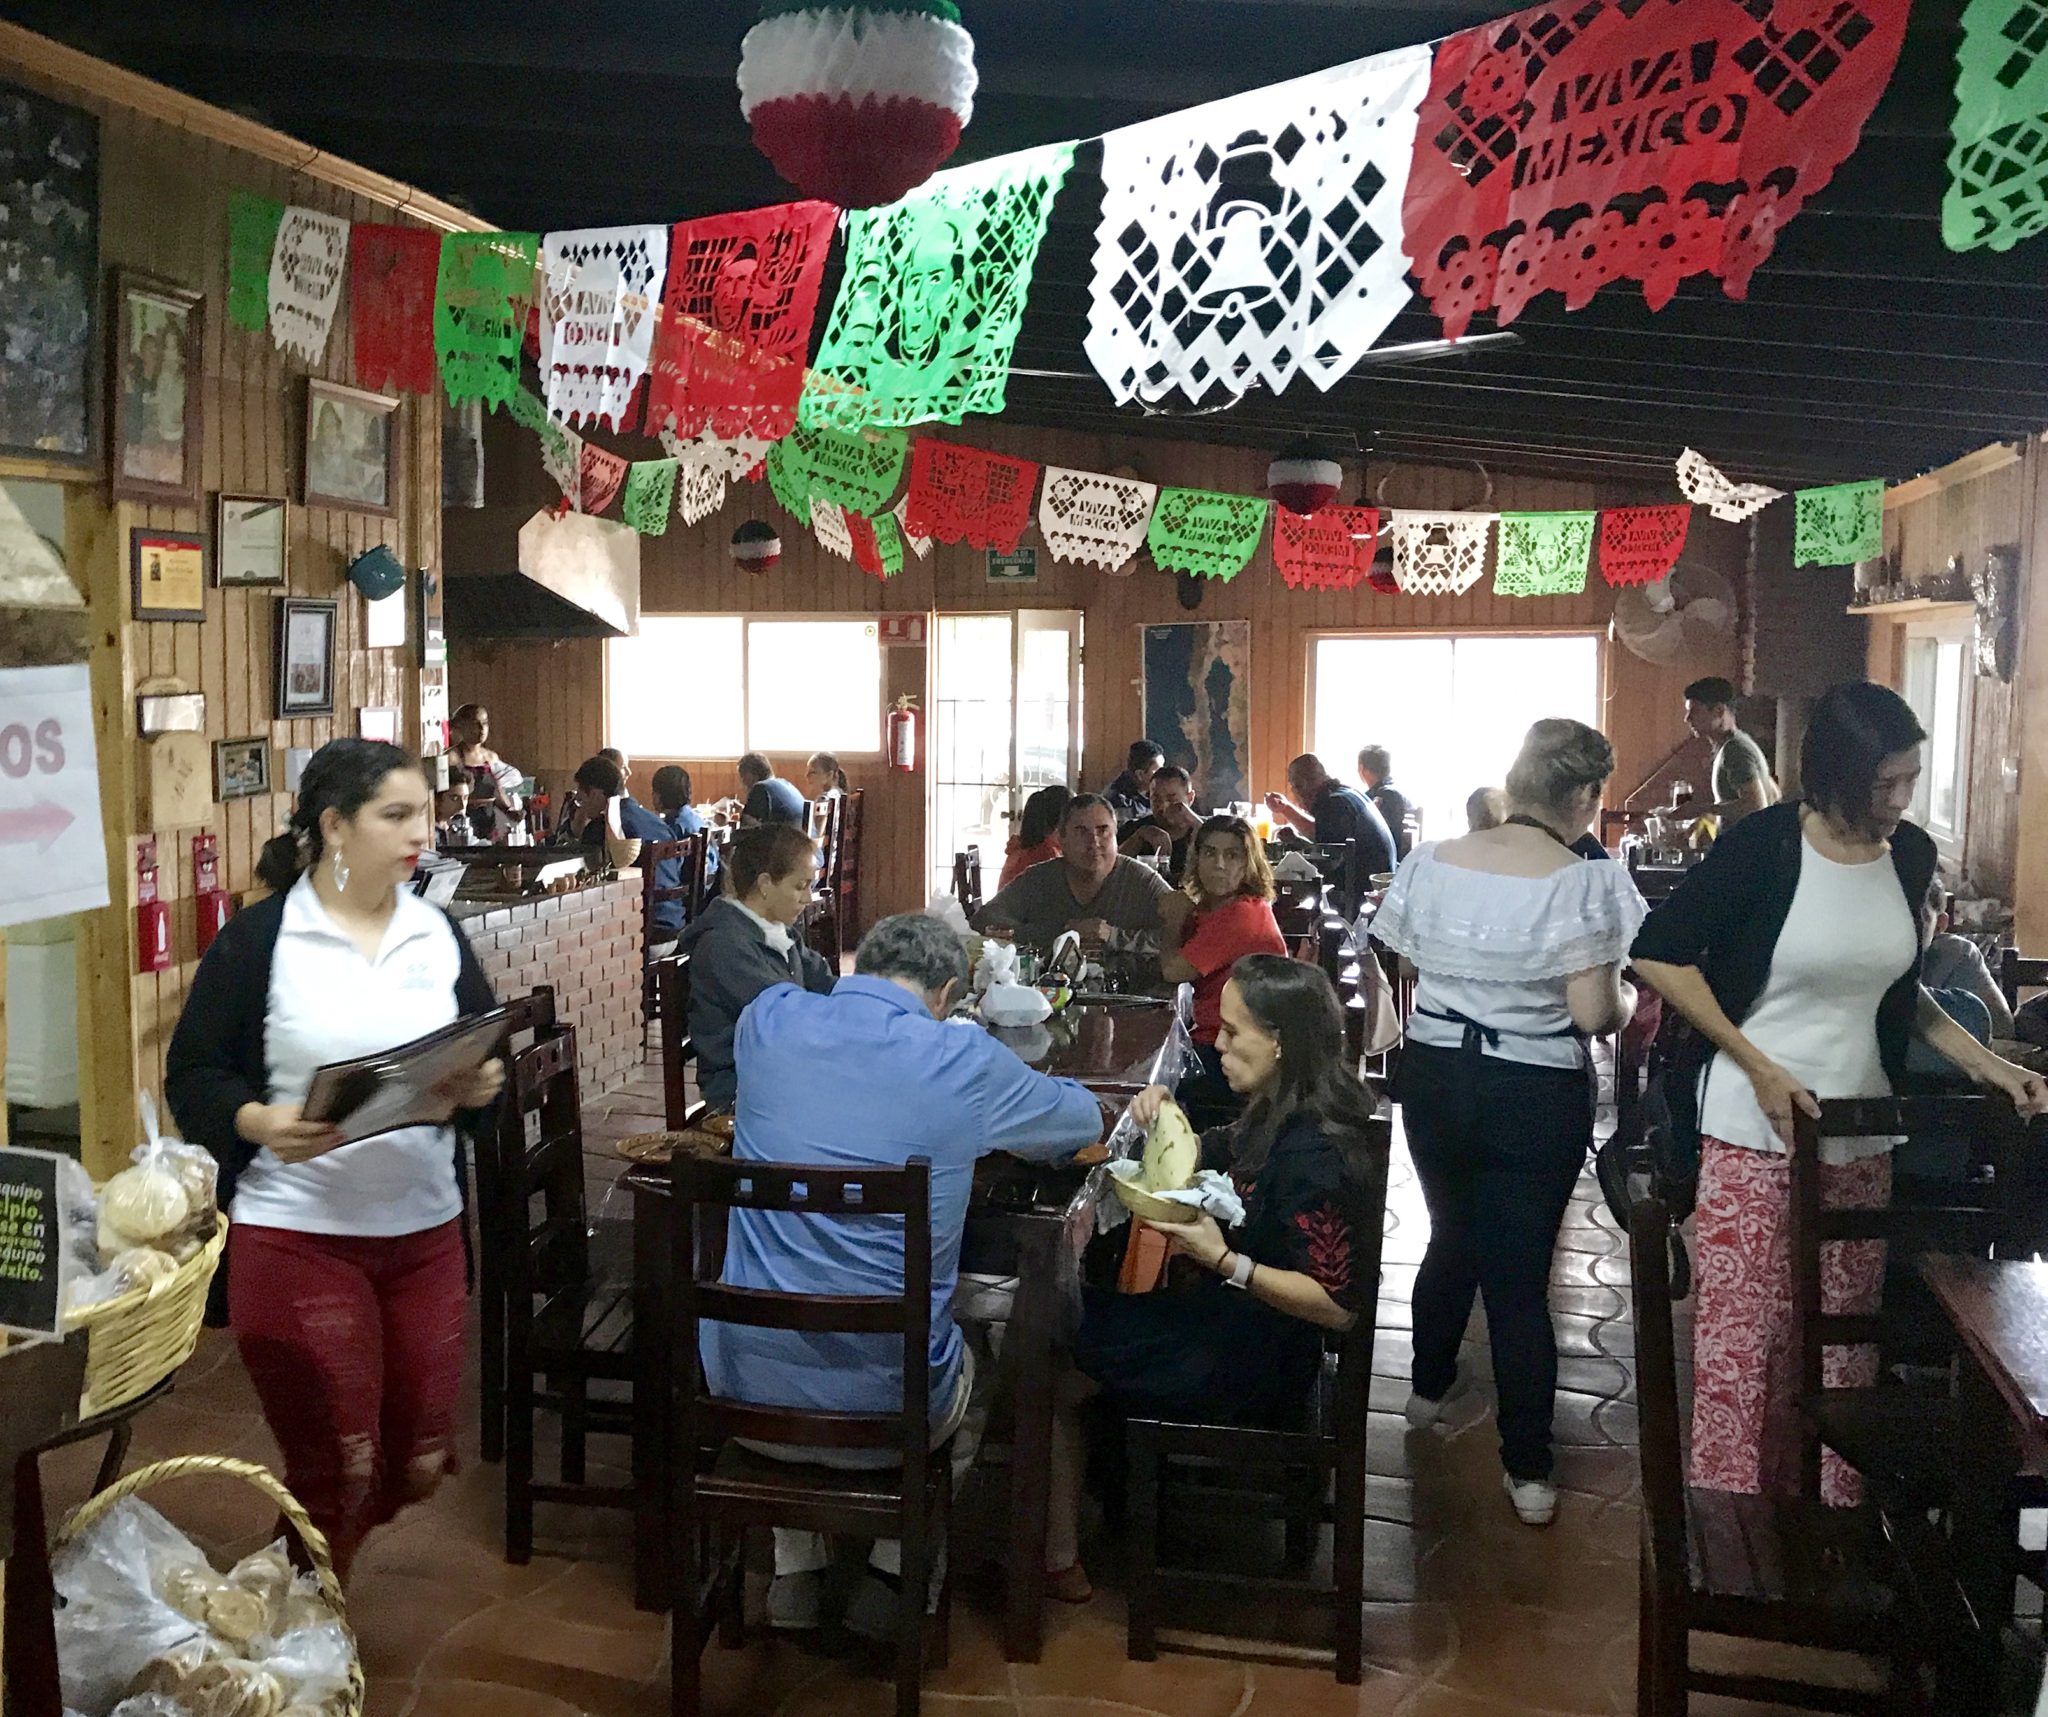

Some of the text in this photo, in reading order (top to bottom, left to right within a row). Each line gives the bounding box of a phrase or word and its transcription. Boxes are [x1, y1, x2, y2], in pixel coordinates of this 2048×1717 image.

[1553, 41, 1716, 122] VIVA
[1512, 94, 1747, 189] MEXICO
[825, 439, 864, 461] VIVA
[814, 451, 870, 478] MEXICO
[1079, 500, 1116, 517] VIVA
[1070, 513, 1119, 532] MEXICO
[1192, 517, 1229, 531] VIVA
[0, 719, 66, 778] OS
[0, 1182, 43, 1206] quipo
[22, 1221, 45, 1237] en
[0, 1247, 46, 1265] quipo
